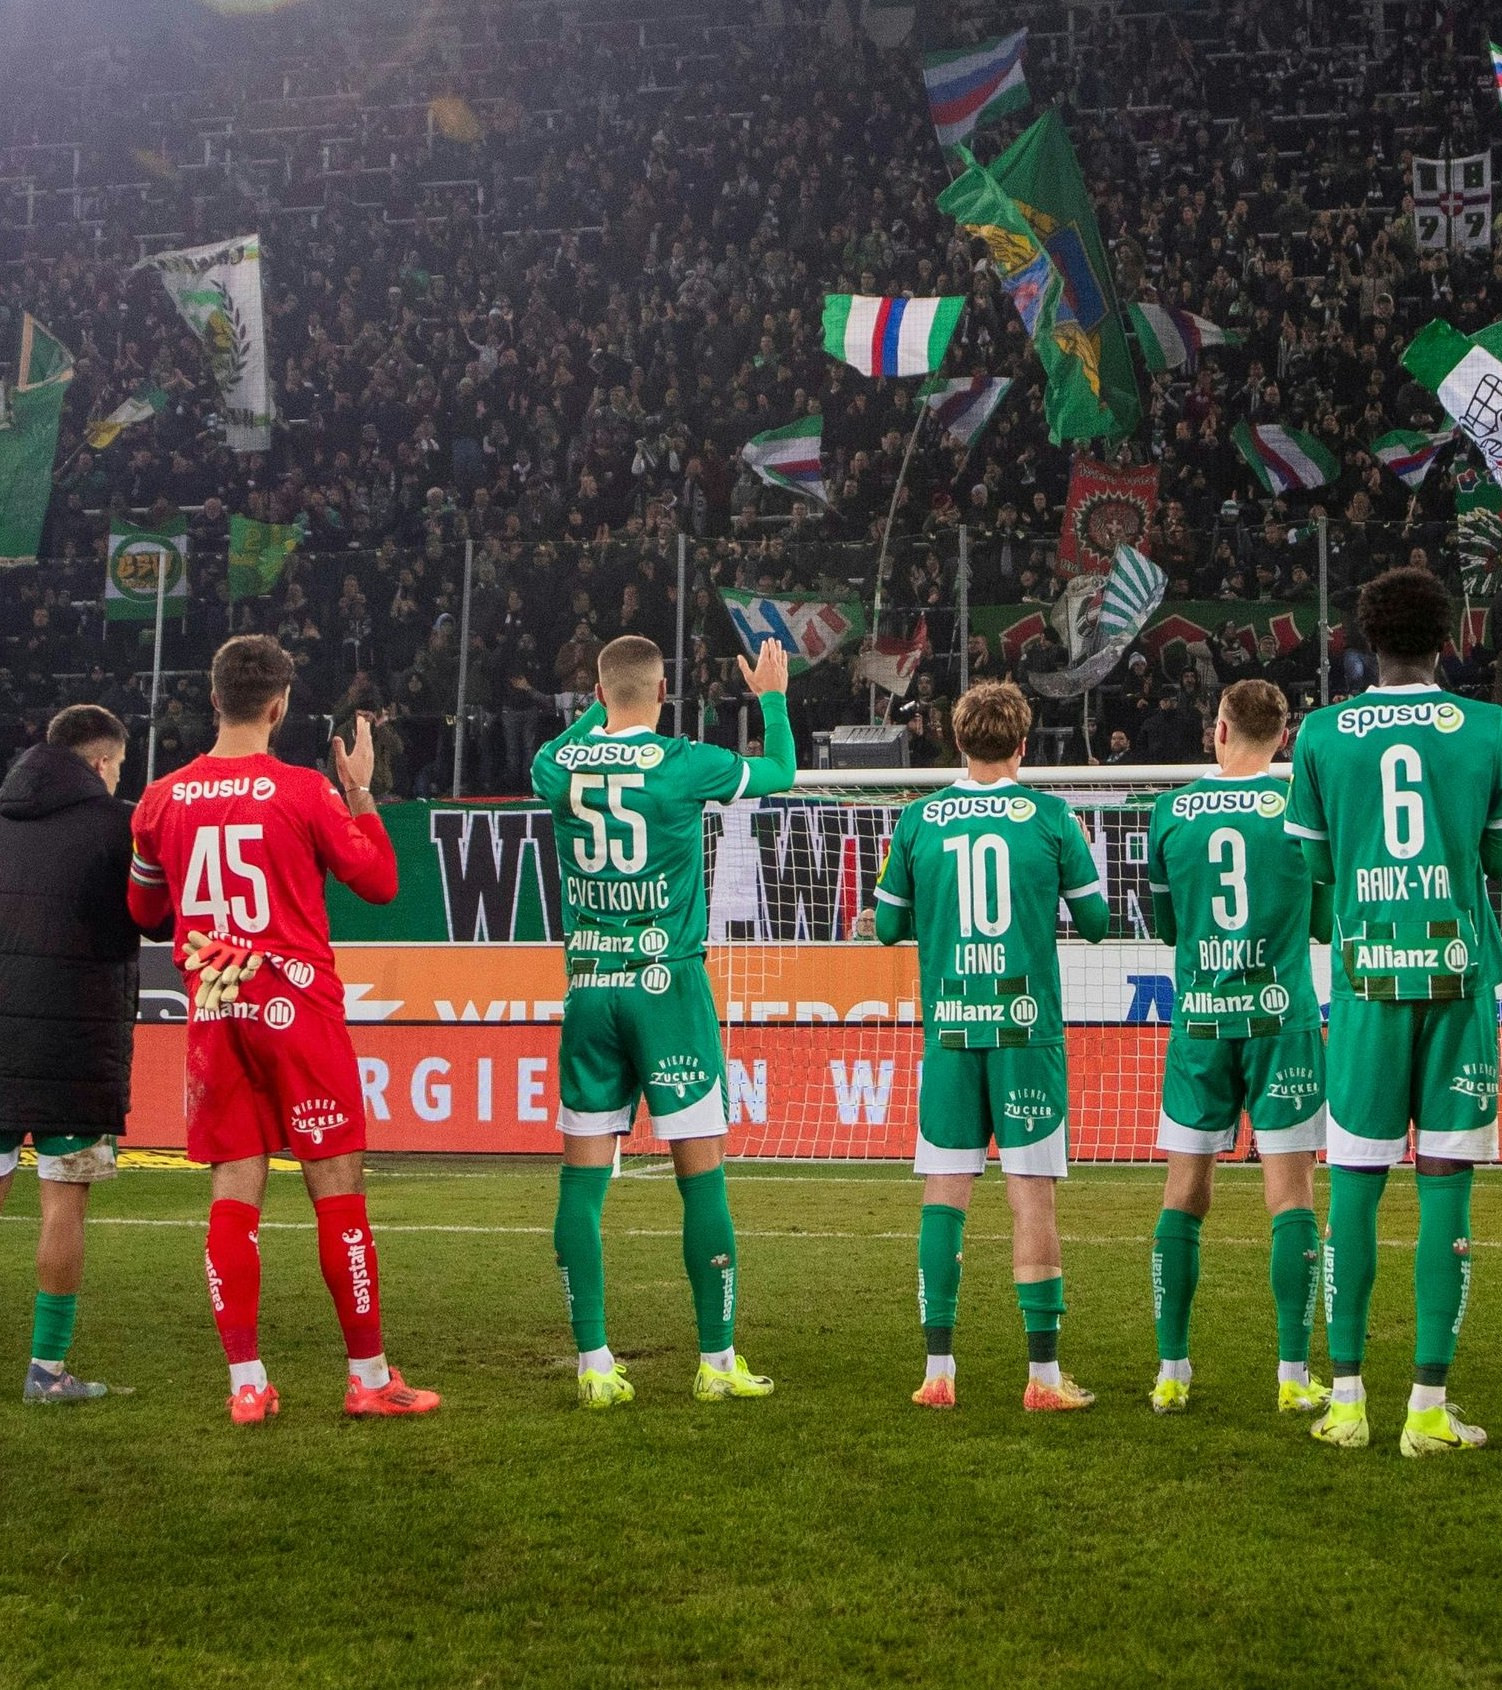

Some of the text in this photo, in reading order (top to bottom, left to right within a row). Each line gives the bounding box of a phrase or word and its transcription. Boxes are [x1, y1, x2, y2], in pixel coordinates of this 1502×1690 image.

[1339, 704, 1433, 737] spusu
[556, 745, 638, 769] spusu
[173, 778, 249, 804] spusu
[1173, 791, 1255, 819] spusu
[1380, 744, 1424, 859] 6
[571, 774, 647, 873] 55
[924, 797, 1006, 825] spusu
[182, 824, 270, 932] 45
[568, 873, 669, 911] CVETKOVIĆ
[943, 834, 1011, 937] 10
[1208, 827, 1248, 930] 3
[1357, 865, 1452, 902] RAUX-YA
[568, 930, 634, 953] Allianz
[1199, 936, 1266, 971] BÖCKLE
[1356, 945, 1438, 969] Allianz
[956, 943, 1005, 974] LANG
[934, 1001, 1005, 1023] Allianz
[1182, 992, 1255, 1014] Allianz
[649, 1069, 709, 1087] ZUCKER
[291, 1112, 348, 1133] ZUCKER
[293, 1099, 336, 1116] WIENER
[346, 1243, 371, 1314] easystaff
[721, 1267, 735, 1322] easystaff
